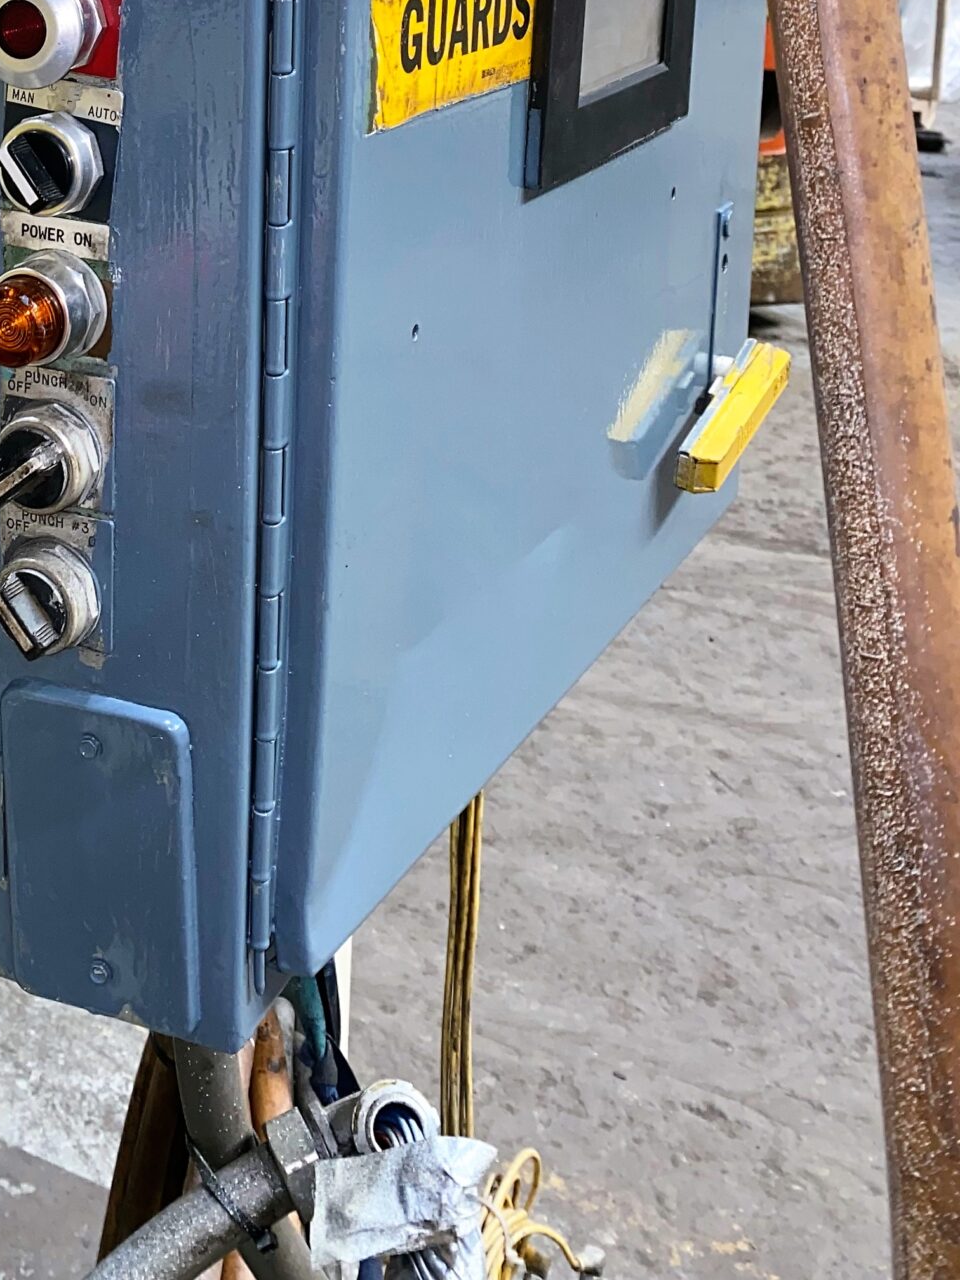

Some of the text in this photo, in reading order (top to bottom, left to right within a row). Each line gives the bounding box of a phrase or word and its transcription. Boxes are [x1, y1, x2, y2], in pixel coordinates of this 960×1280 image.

[12, 89, 35, 104] MAN
[88, 106, 117, 121] AUTO
[21, 223, 92, 248] POWER ON
[25, 370, 68, 389] PUNCH
[8, 380, 107, 408] OFF ON
[6, 518, 30, 532] OFF
[22, 509, 89, 534] PUNCH #3
